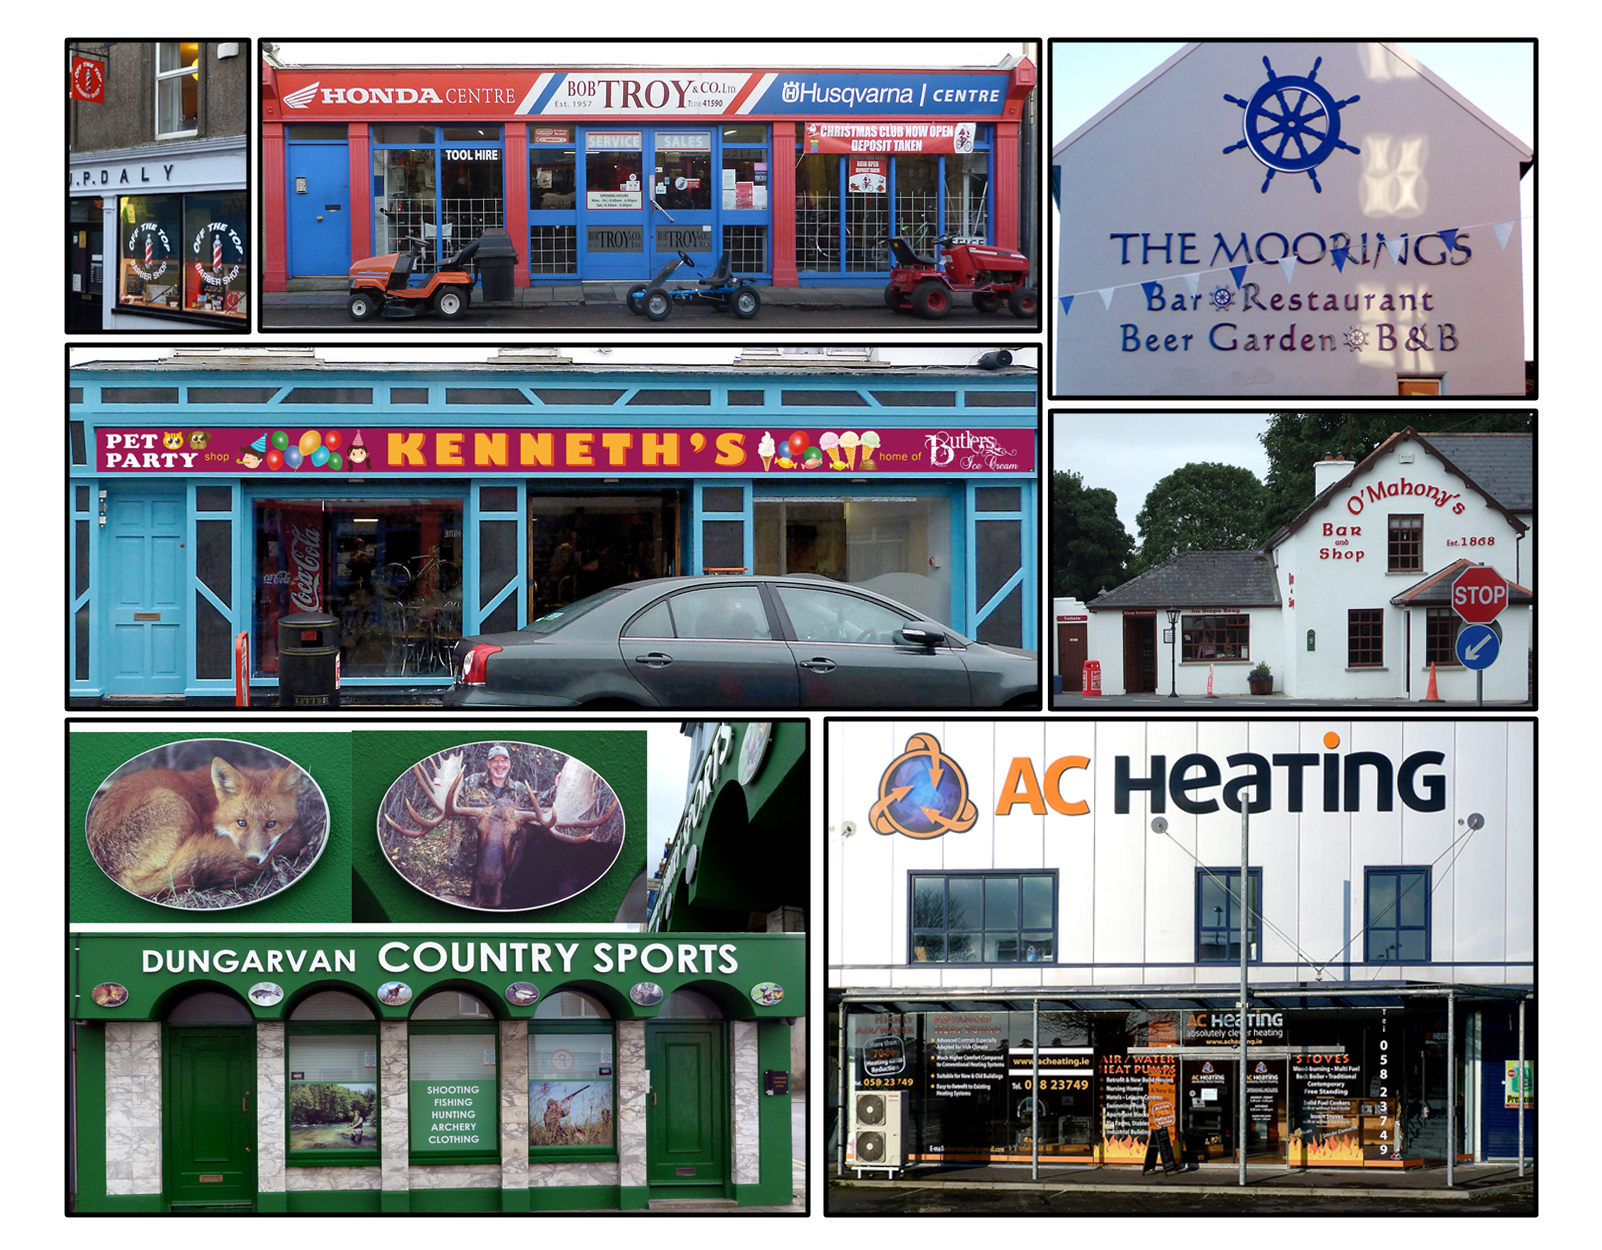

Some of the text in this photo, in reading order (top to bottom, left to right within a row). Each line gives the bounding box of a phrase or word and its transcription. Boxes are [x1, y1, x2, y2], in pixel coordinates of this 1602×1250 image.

[320, 87, 516, 104] HONDA CENTRE
[567, 80, 596, 97] BOB
[597, 79, 696, 109] TROY
[692, 85, 699, 94] &
[801, 82, 1000, 108] Husqvarna CENTRE
[555, 100, 593, 108] Est. 1957
[702, 99, 724, 107] 41590
[820, 124, 954, 138] CHRISTMAS CLUB NOW OPEN
[588, 135, 640, 148] SERVICE
[664, 135, 703, 148] SALES
[851, 139, 923, 152] DEPOSIT TAKEN
[445, 149, 498, 161] TOOL HIRE
[129, 222, 171, 253] OFF THE TOP
[193, 222, 244, 255] OFF THE TOP
[598, 230, 631, 249] TROY
[667, 230, 698, 249] TROY
[1110, 231, 1473, 268] THE MOORINGS
[130, 259, 168, 280] BARBER SHOP
[194, 262, 240, 287] BARBER SHOP
[1147, 282, 1435, 313] Bar Restaurant
[1120, 322, 1194, 352] Beer
[1208, 322, 1337, 352] Garden
[105, 433, 158, 449] PET
[387, 432, 747, 467] KENNETH'S
[925, 430, 1008, 467] Butlers
[105, 452, 230, 468] PARTY shop
[879, 451, 923, 461] home of
[960, 453, 1020, 471] Ice Cream
[1347, 477, 1466, 515] O'Mahony's
[1335, 538, 1350, 546] and
[1446, 536, 1496, 547] Est. 1868
[1319, 547, 1365, 562] Shop
[1455, 585, 1506, 605] STOP
[994, 756, 1091, 816] AC
[142, 941, 739, 974] DUNGARVAN COUNTRY SPORTS
[934, 1015, 992, 1023] ADVANCED
[1187, 1014, 1207, 1028] AC
[934, 1026, 1002, 1034] HEAT PUMPS
[1186, 1029, 1226, 1038] absolutely
[1253, 1029, 1283, 1038] heating
[1099, 1054, 1176, 1064] AIR WATER
[1296, 1053, 1350, 1064] STOVES
[1099, 1065, 1176, 1074] HEAT PUMPS
[863, 1078, 882, 1087] 058
[883, 1078, 914, 1087] 23749
[1024, 1080, 1047, 1090] 08
[1050, 1080, 1089, 1090] 23749
[427, 1085, 480, 1095] SHOOTING
[434, 1097, 474, 1107] FISHING
[431, 1110, 476, 1119] HUNTING
[431, 1122, 477, 1132] ARCHERY
[428, 1135, 480, 1144] CLOTHING
